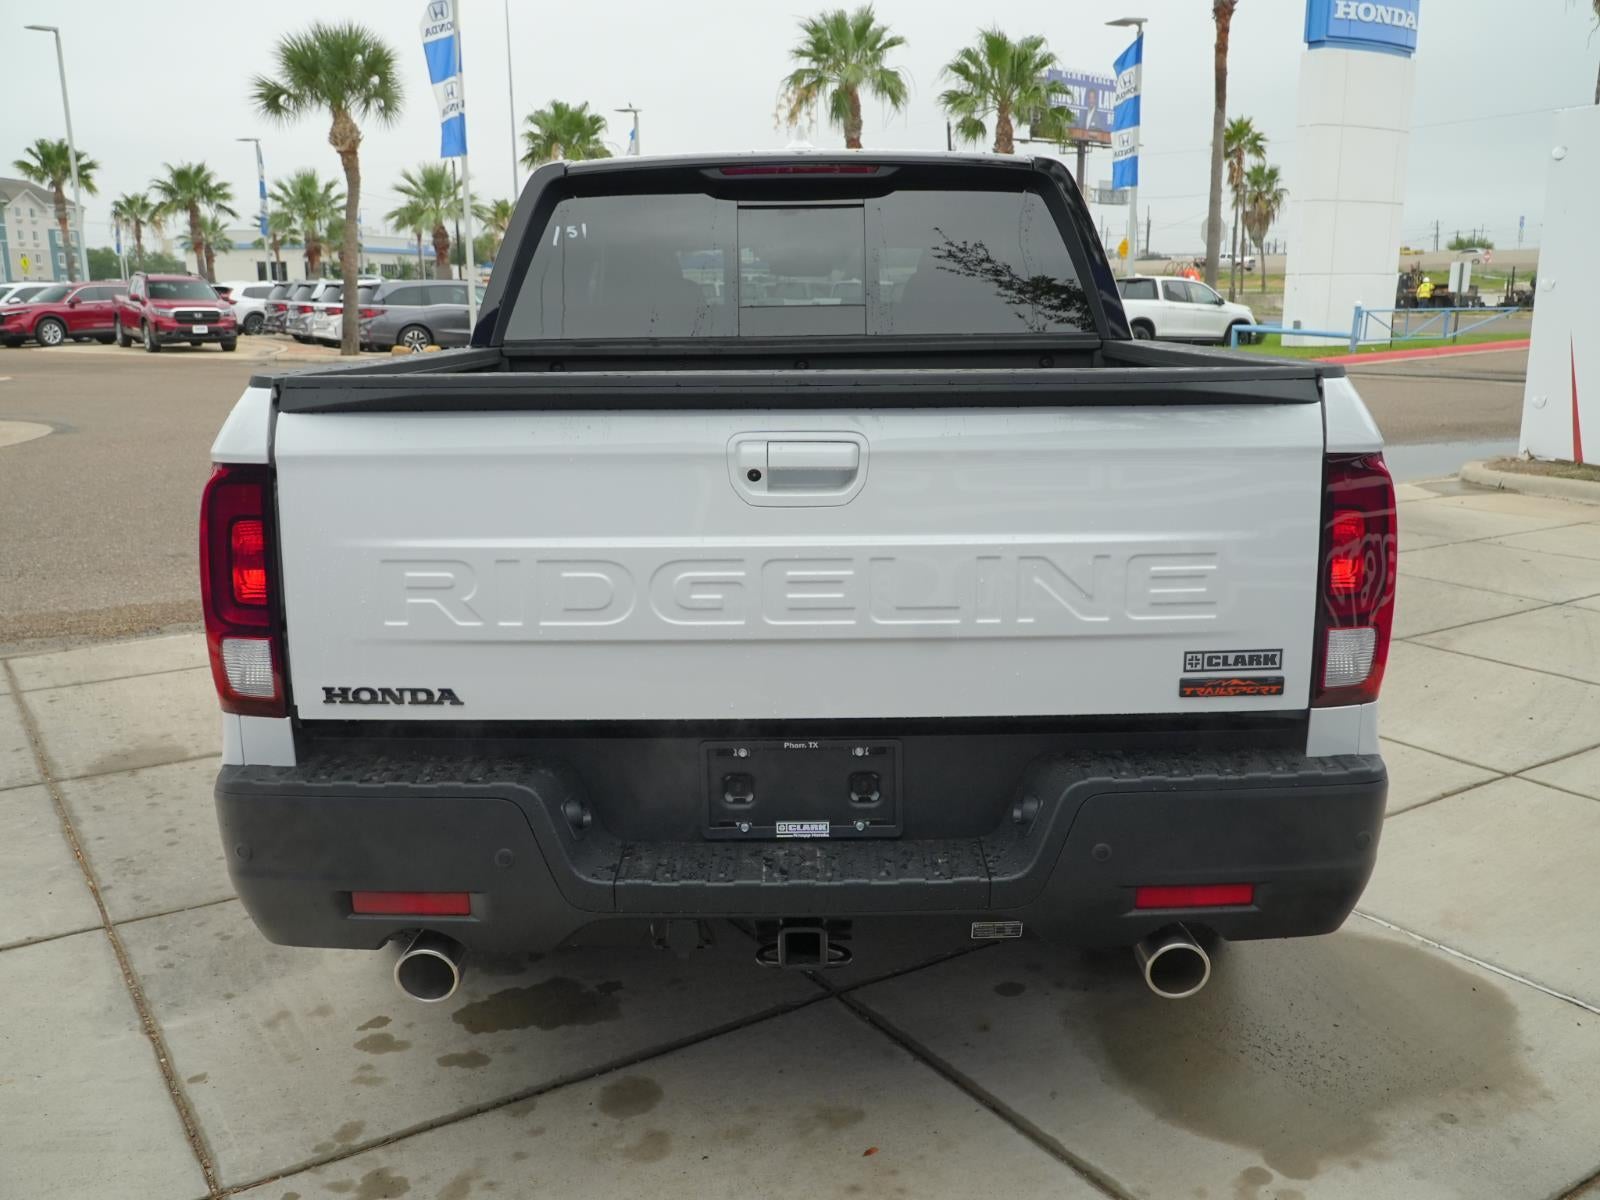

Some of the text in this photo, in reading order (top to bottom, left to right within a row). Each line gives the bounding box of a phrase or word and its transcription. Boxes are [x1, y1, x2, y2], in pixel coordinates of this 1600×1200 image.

[1335, 0, 1417, 31] HONDA
[380, 552, 1217, 626] RIDGELINE
[1206, 653, 1278, 668] CLARK
[321, 687, 465, 706] HONDA
[1183, 685, 1281, 697] TRAILSPORT
[808, 741, 818, 749] TX
